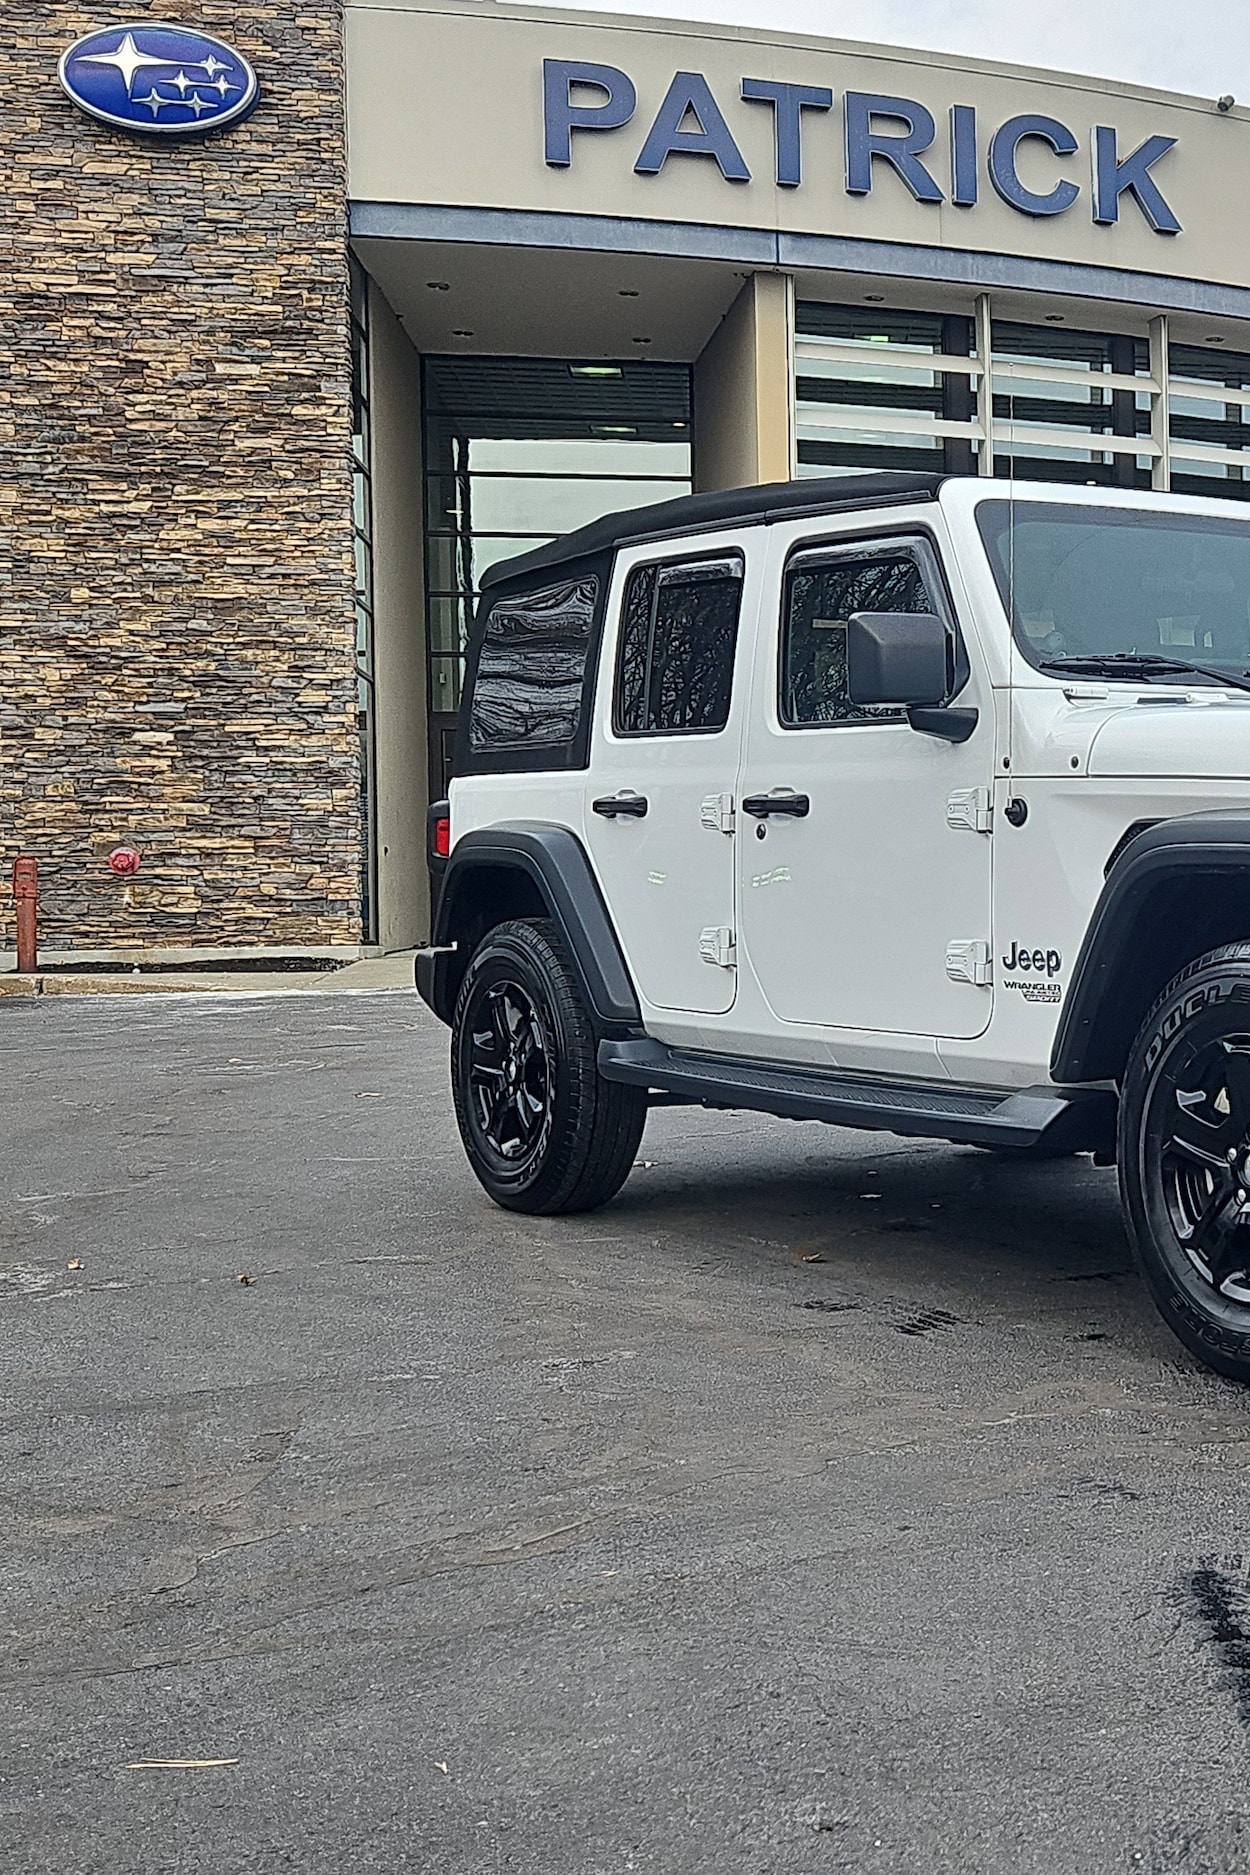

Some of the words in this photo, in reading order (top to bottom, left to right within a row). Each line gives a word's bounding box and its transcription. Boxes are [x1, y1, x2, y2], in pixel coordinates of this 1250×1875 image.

[542, 57, 1184, 235] PATRICK
[1002, 940, 1062, 978] Jeep
[1003, 980, 1061, 991] WRANGLER
